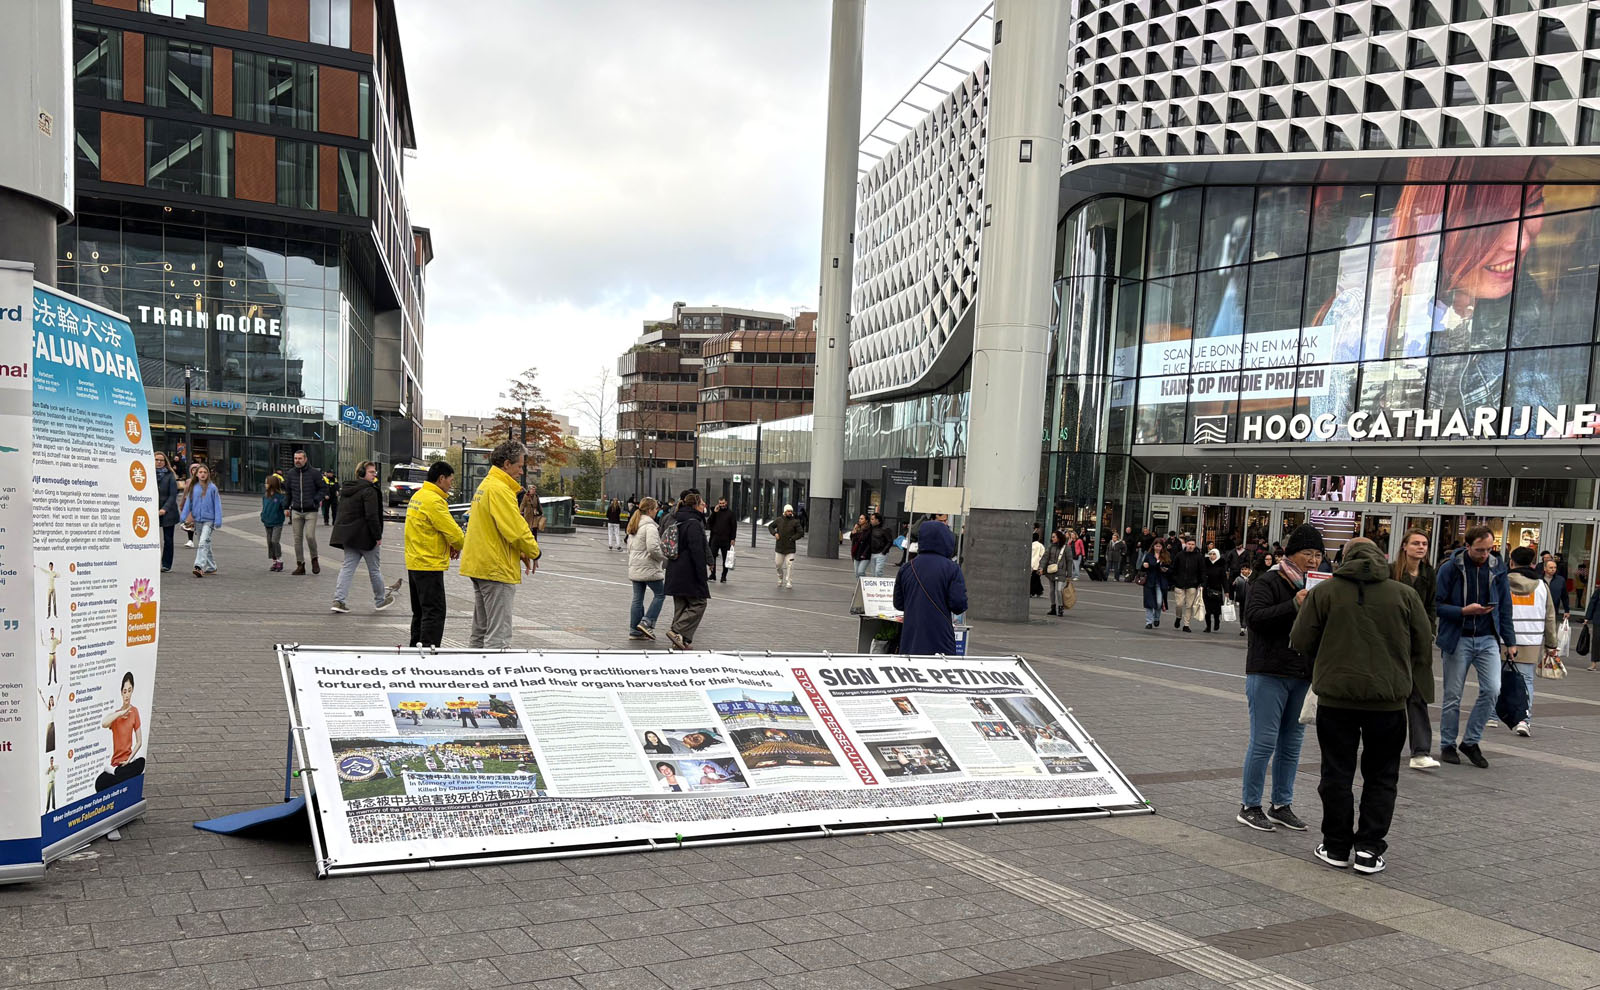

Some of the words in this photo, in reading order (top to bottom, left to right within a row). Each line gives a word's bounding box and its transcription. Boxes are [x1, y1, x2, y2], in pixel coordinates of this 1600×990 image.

[0, 306, 21, 322] rd
[33, 297, 121, 348] 法輪大法
[138, 306, 209, 330] TRAIN
[216, 314, 282, 336] MORE
[1163, 348, 1191, 361] SCAN
[1194, 346, 1206, 358] JE
[1210, 342, 1258, 356] BONNEN
[1263, 340, 1277, 353] EN
[1281, 336, 1319, 351] MAAK
[0, 363, 27, 377] na!
[91, 347, 139, 382] DAFA
[1162, 363, 1186, 375] ELKE
[1220, 360, 1235, 371] EN
[1268, 352, 1315, 368] MAAND
[1161, 377, 1194, 396] KANS
[1197, 377, 1215, 394] OP
[1218, 374, 1262, 393] MOOIE
[1265, 370, 1324, 390] PRIJZEN
[172, 396, 209, 408] Alert
[212, 399, 242, 410] Heijn
[126, 420, 140, 437] 真
[1243, 412, 1339, 442] HOOG
[1347, 404, 1600, 440] CATHARIJNE
[42, 477, 70, 486] eenvoudige
[71, 479, 98, 487] oefeningen
[132, 467, 145, 483] 善
[1171, 478, 1200, 491] DOUGLA
[128, 634, 152, 642] Workshop
[315, 666, 388, 675] Hundreds
[392, 667, 406, 675] of
[410, 667, 484, 676] thousands
[488, 667, 501, 675] of
[504, 666, 541, 675] Falun
[544, 666, 577, 676] Gong
[579, 667, 658, 676] practitioners
[660, 667, 689, 675] have
[721, 666, 784, 677] persecuted,
[819, 668, 880, 686] SIGN
[879, 666, 929, 684] THE
[927, 668, 1024, 687] PETITION
[317, 680, 386, 690] tortured,
[389, 680, 416, 688] and
[492, 680, 518, 688] and
[520, 677, 546, 687] had
[548, 678, 578, 686] their
[582, 681, 624, 689] organs
[626, 679, 687, 688] harvested
[708, 677, 735, 685] their
[736, 677, 773, 687] beliefs
[795, 669, 816, 694] STOP
[811, 695, 829, 715] THE
[824, 715, 875, 784] PERSECUTION
[347, 790, 546, 810] 悼念被中共迫害致死的法輪功學
[53, 814, 64, 823] Meer
[68, 801, 114, 828] www.FalunDafa.org
